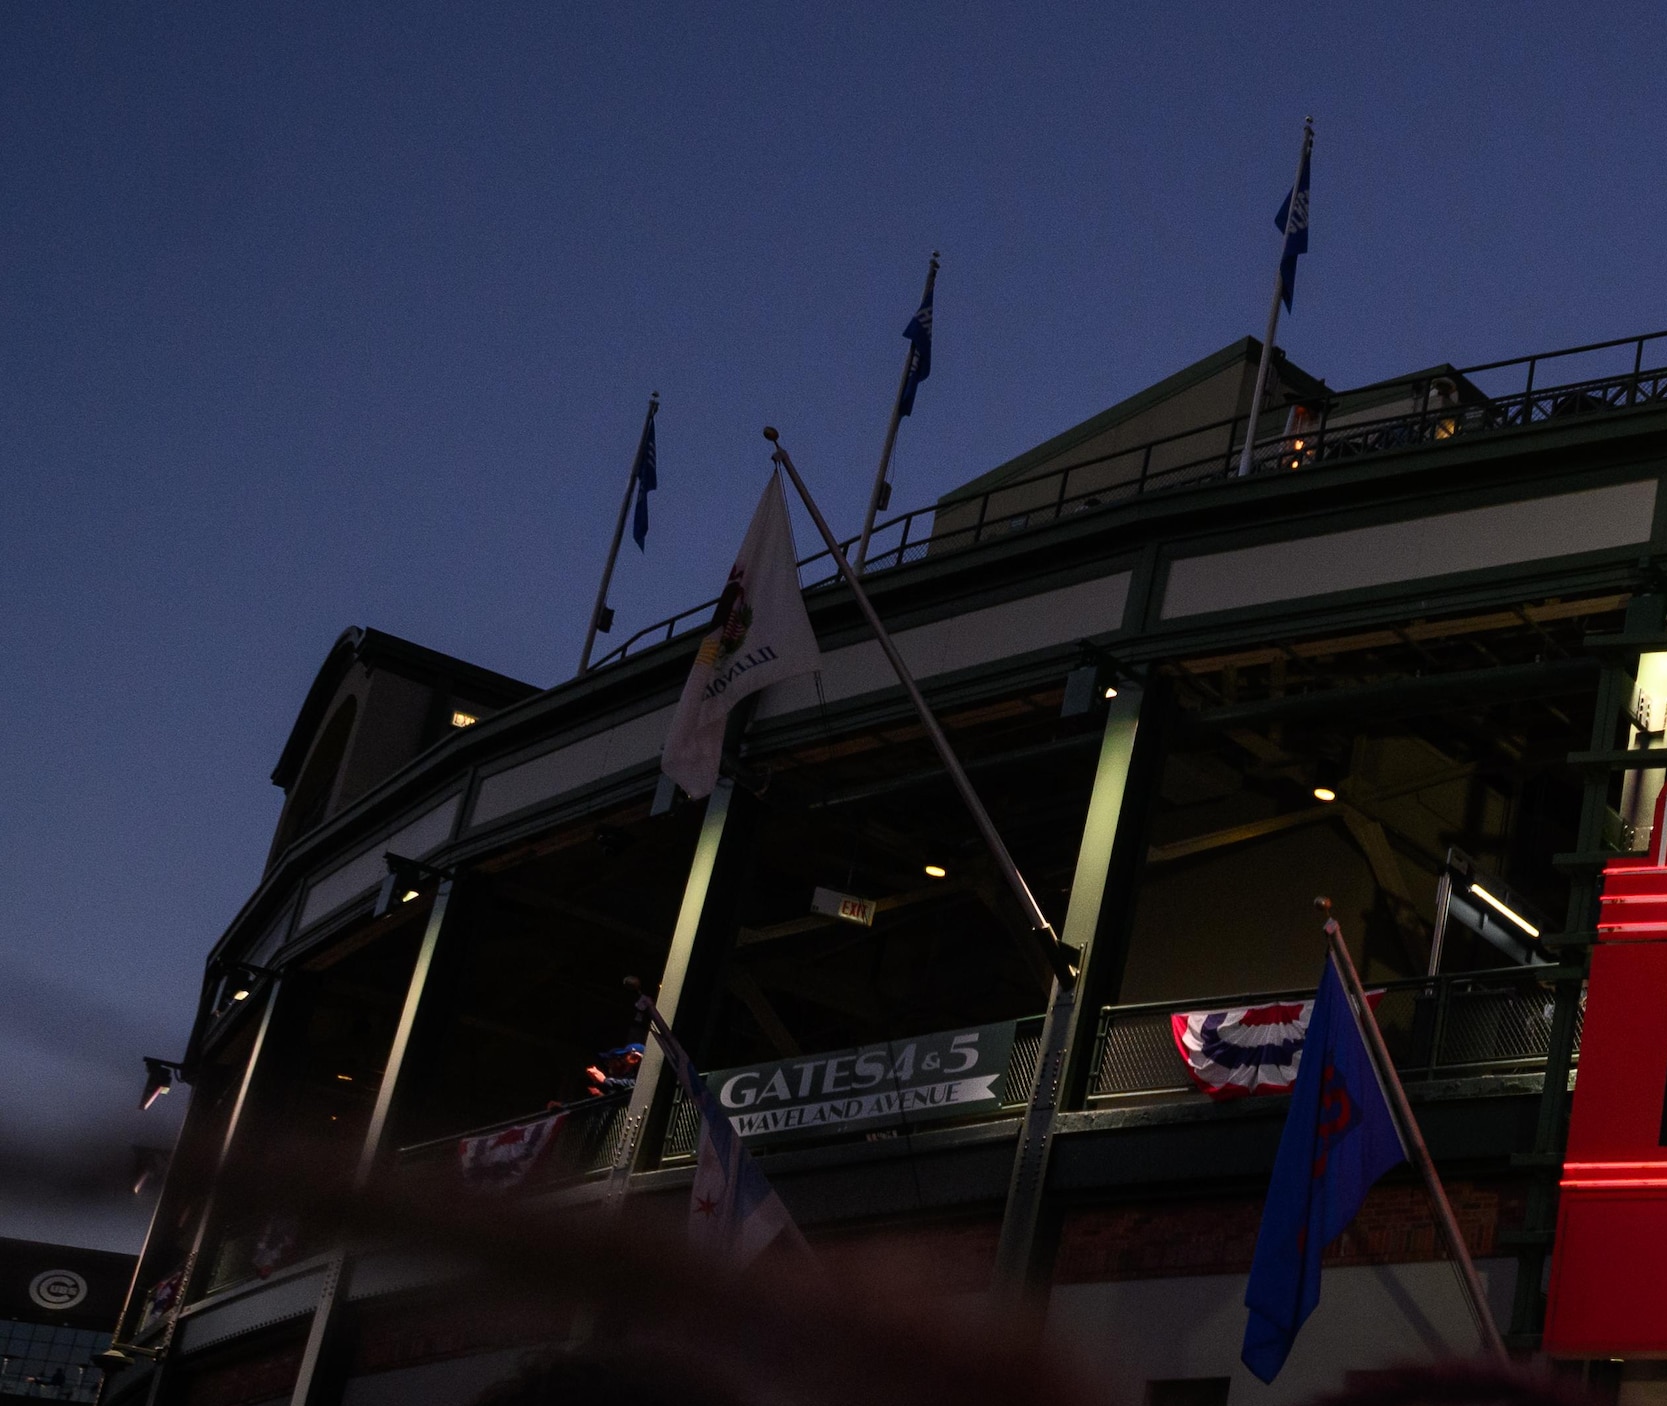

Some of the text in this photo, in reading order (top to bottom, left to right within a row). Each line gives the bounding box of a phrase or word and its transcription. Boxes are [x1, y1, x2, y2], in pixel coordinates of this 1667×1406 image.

[719, 1032, 980, 1109] GATES 4 & 5
[738, 1084, 960, 1133] WAVELAND AVENUE
